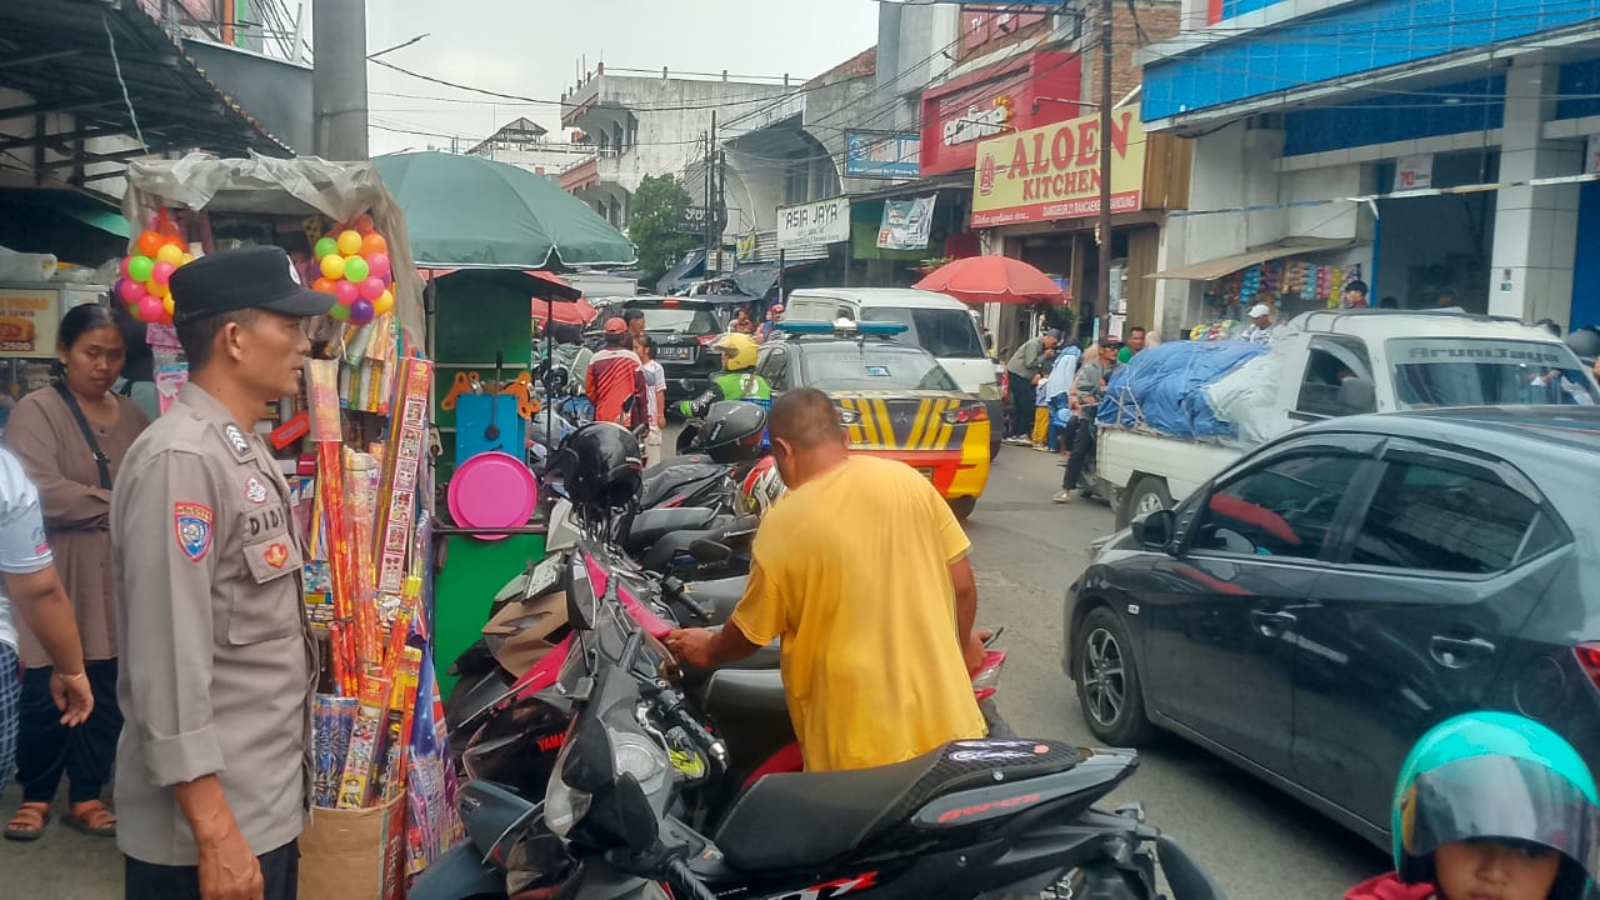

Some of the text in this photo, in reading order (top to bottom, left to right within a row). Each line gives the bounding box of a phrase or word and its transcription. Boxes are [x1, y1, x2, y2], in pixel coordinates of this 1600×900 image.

[1007, 111, 1132, 181] ALOEN
[1022, 168, 1102, 201] KITCHEN
[785, 203, 837, 230] ASIA JAYA
[249, 507, 285, 536] DIDI
[537, 732, 566, 752] YAMA
